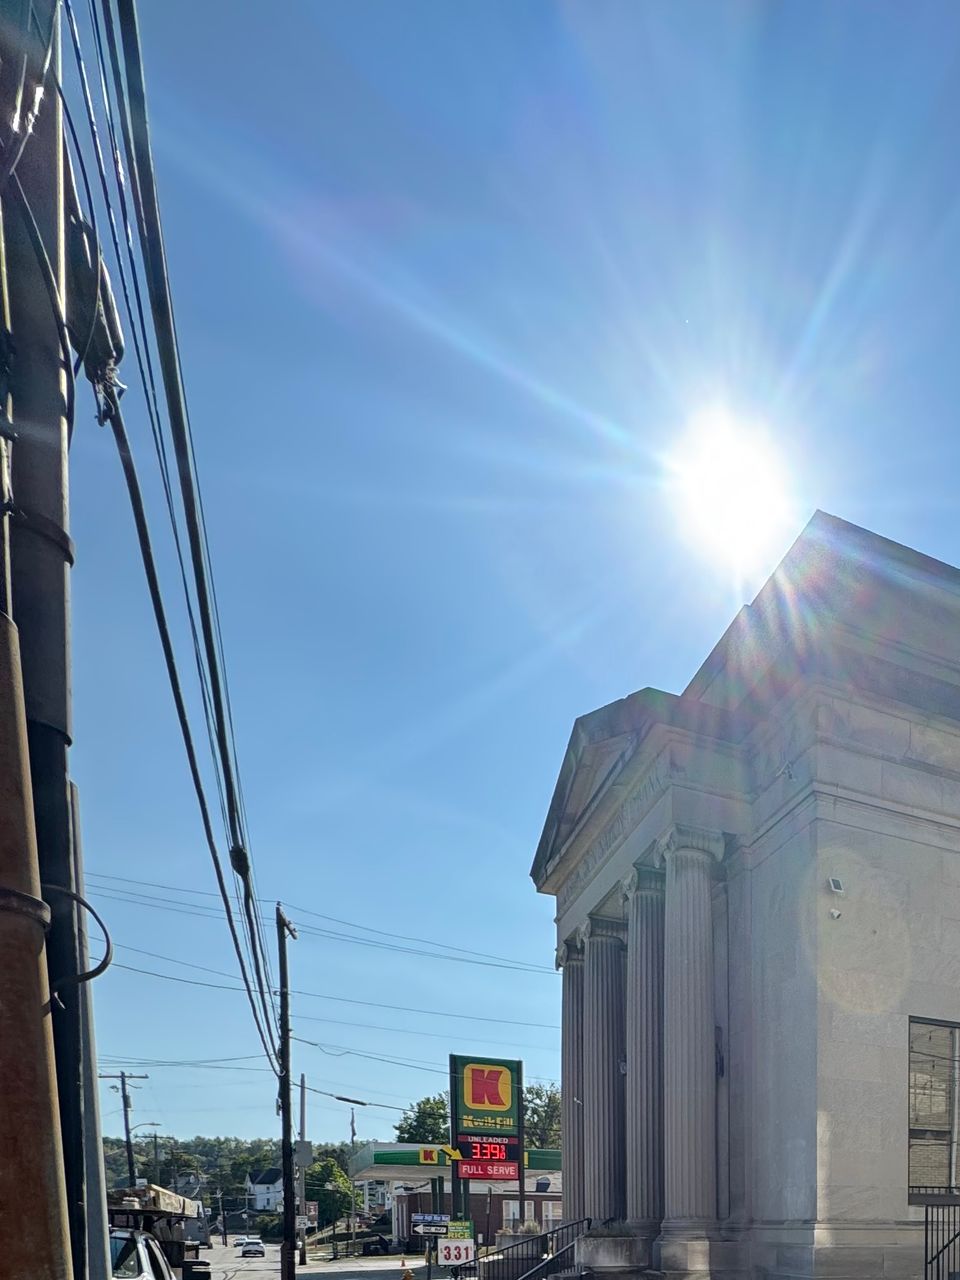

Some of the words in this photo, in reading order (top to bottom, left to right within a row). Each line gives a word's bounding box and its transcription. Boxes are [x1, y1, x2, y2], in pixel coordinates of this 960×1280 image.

[472, 1069, 505, 1105] K
[462, 1165, 484, 1174] FULL
[487, 1166, 515, 1175] SERVE
